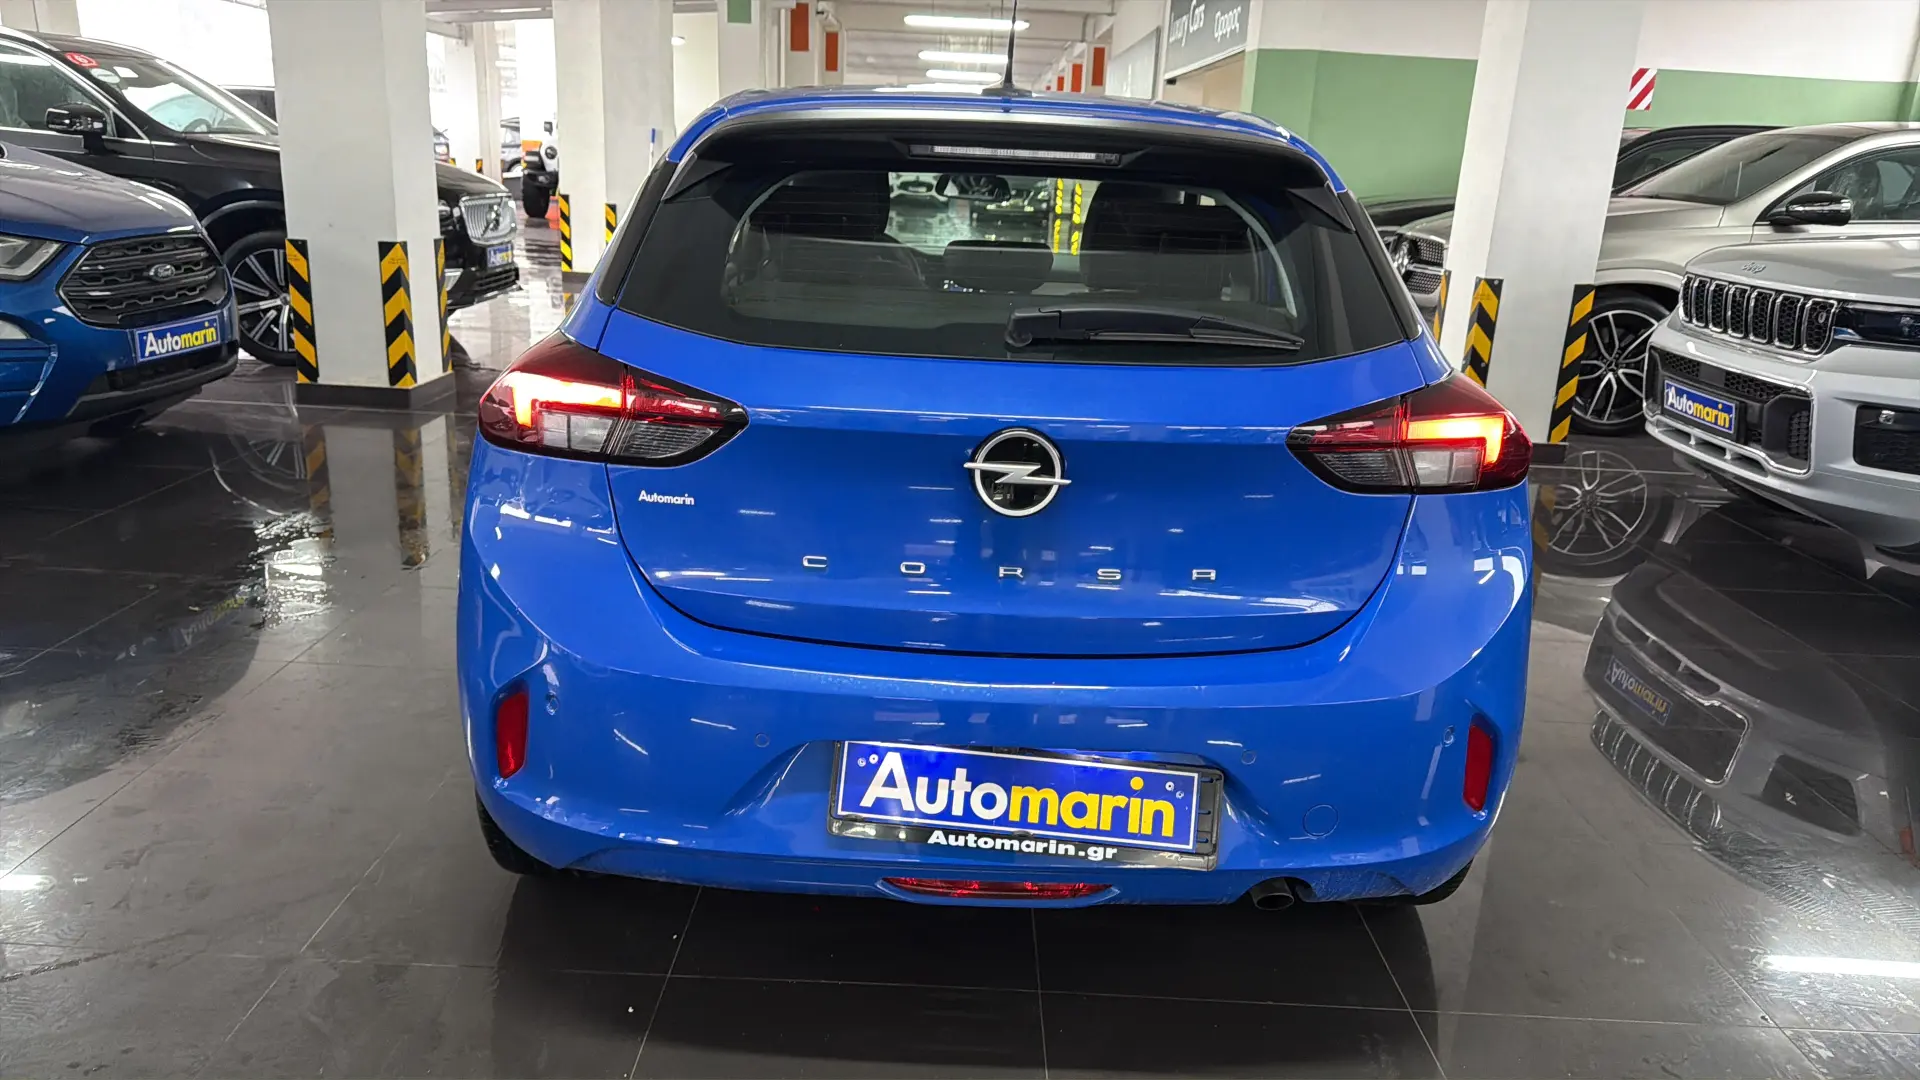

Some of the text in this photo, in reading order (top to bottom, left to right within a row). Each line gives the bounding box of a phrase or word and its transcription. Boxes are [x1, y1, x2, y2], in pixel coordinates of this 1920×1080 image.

[1189, 0, 1205, 33] Cars
[145, 321, 217, 357] Automarin
[1667, 386, 1730, 429] Automarin
[638, 489, 695, 505] Automarin
[802, 555, 1217, 581] CORSA
[860, 751, 1175, 837] Automarin
[927, 829, 1118, 861] Automarin.gr
